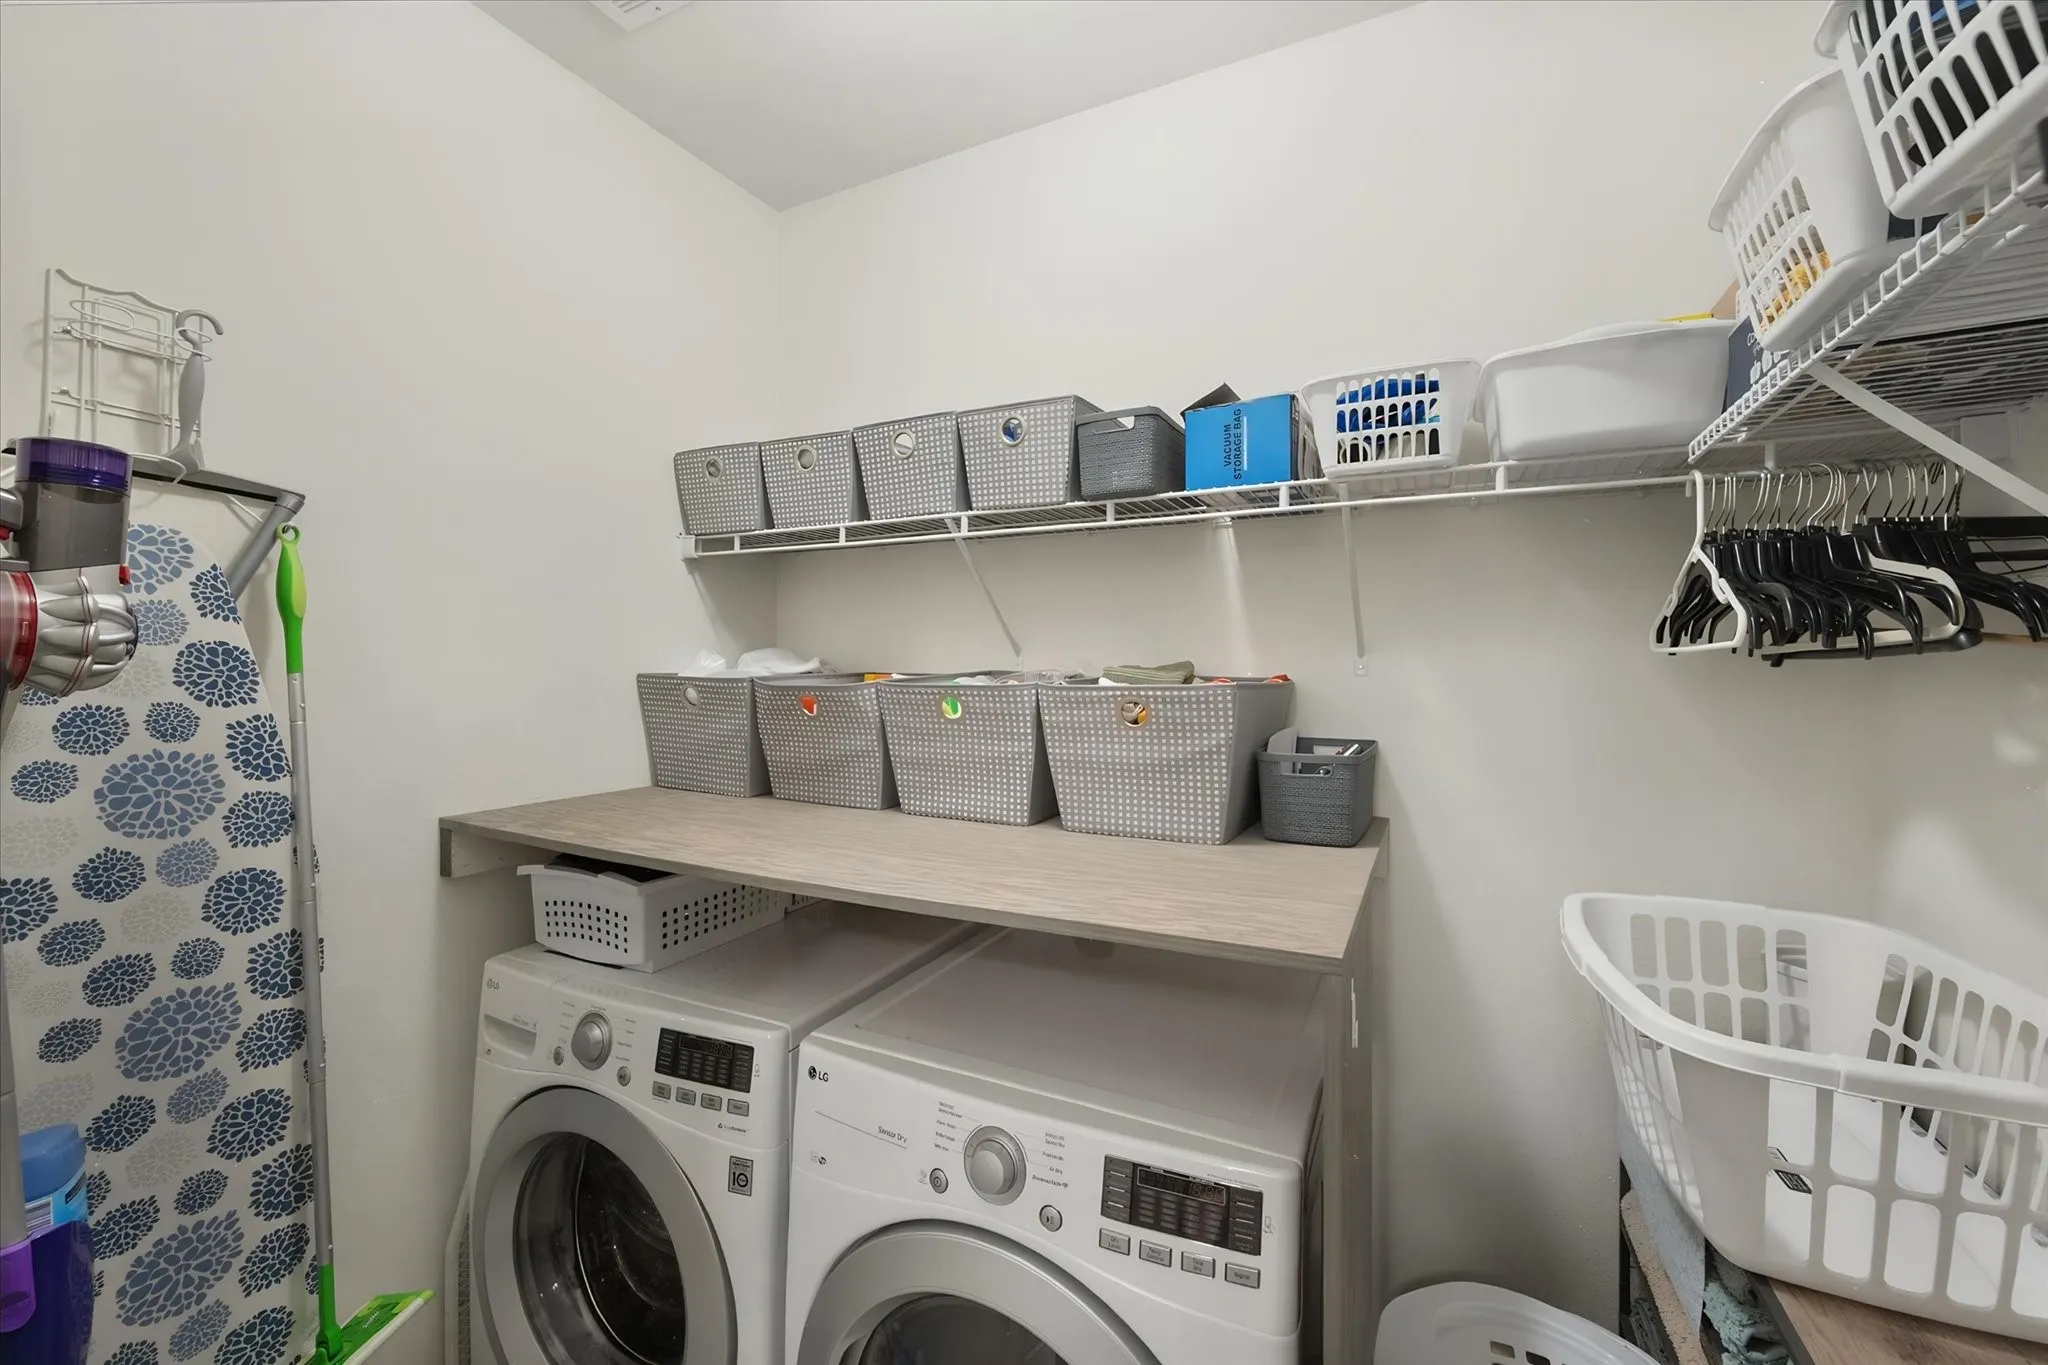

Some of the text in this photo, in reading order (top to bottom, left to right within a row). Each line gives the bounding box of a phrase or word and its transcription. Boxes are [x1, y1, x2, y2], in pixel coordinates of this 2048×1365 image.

[1223, 423, 1232, 468] VACUUM
[1233, 408, 1242, 480] STORAGE BAG
[878, 1125, 897, 1139] Sensor
[733, 1171, 750, 1188] 10
